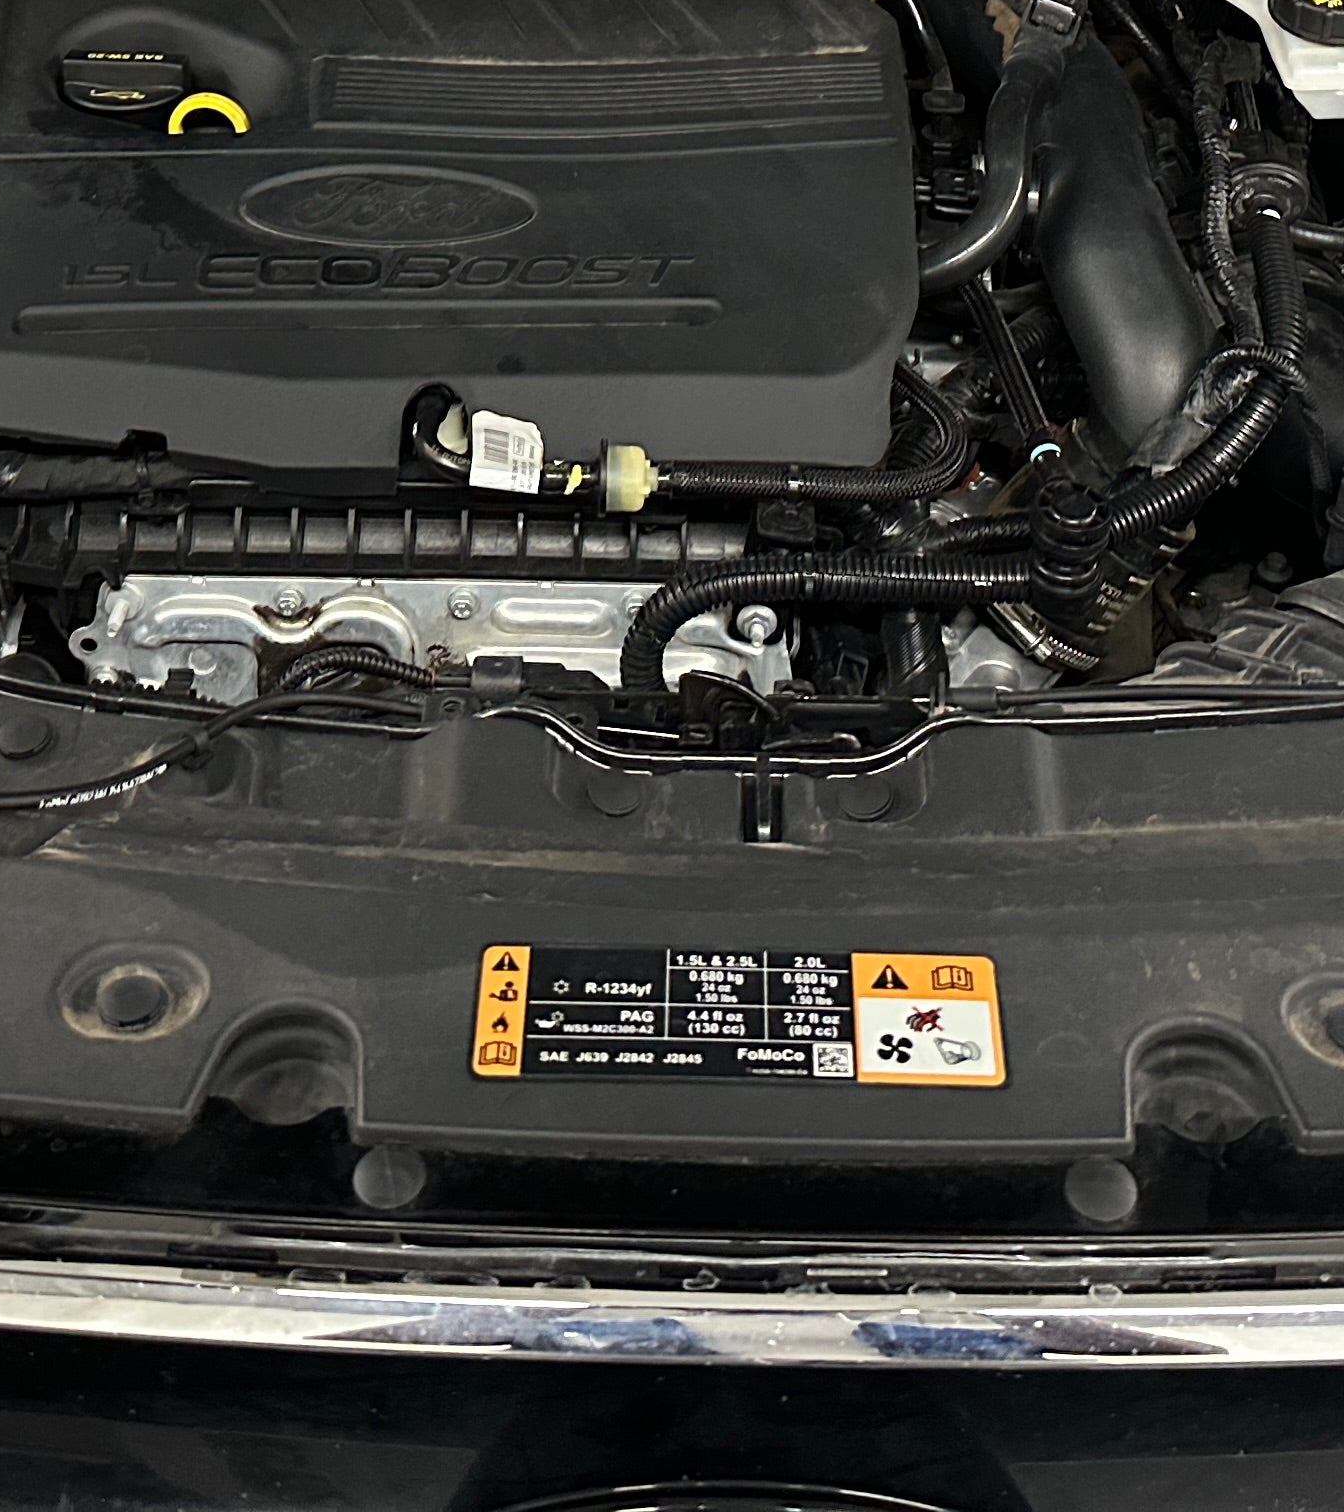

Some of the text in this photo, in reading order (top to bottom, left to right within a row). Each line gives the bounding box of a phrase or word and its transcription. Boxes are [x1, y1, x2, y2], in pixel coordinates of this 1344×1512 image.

[293, 174, 498, 235] Ford
[676, 954, 758, 967] 1.5L & 2.5L
[794, 956, 826, 968] 2.0L
[689, 970, 744, 985] 0.680 kg
[782, 972, 838, 987] 0.680 kg
[585, 982, 652, 997] R-1234yf
[701, 982, 732, 993] 24 oz
[796, 985, 826, 995] 24 oz
[696, 993, 738, 1003] 1.50 lbs
[790, 995, 834, 1005] 1.50 lbs
[620, 1010, 654, 1022] PAG
[687, 1010, 744, 1022] 4.4 fl oz
[783, 1012, 840, 1024] 2.7 fl oz
[688, 1022, 745, 1036] (130 cc)
[789, 1025, 838, 1038] (80 cc)
[539, 1051, 703, 1064] SAE J639 J2842 J2845
[737, 1048, 805, 1061] FoMoCo
